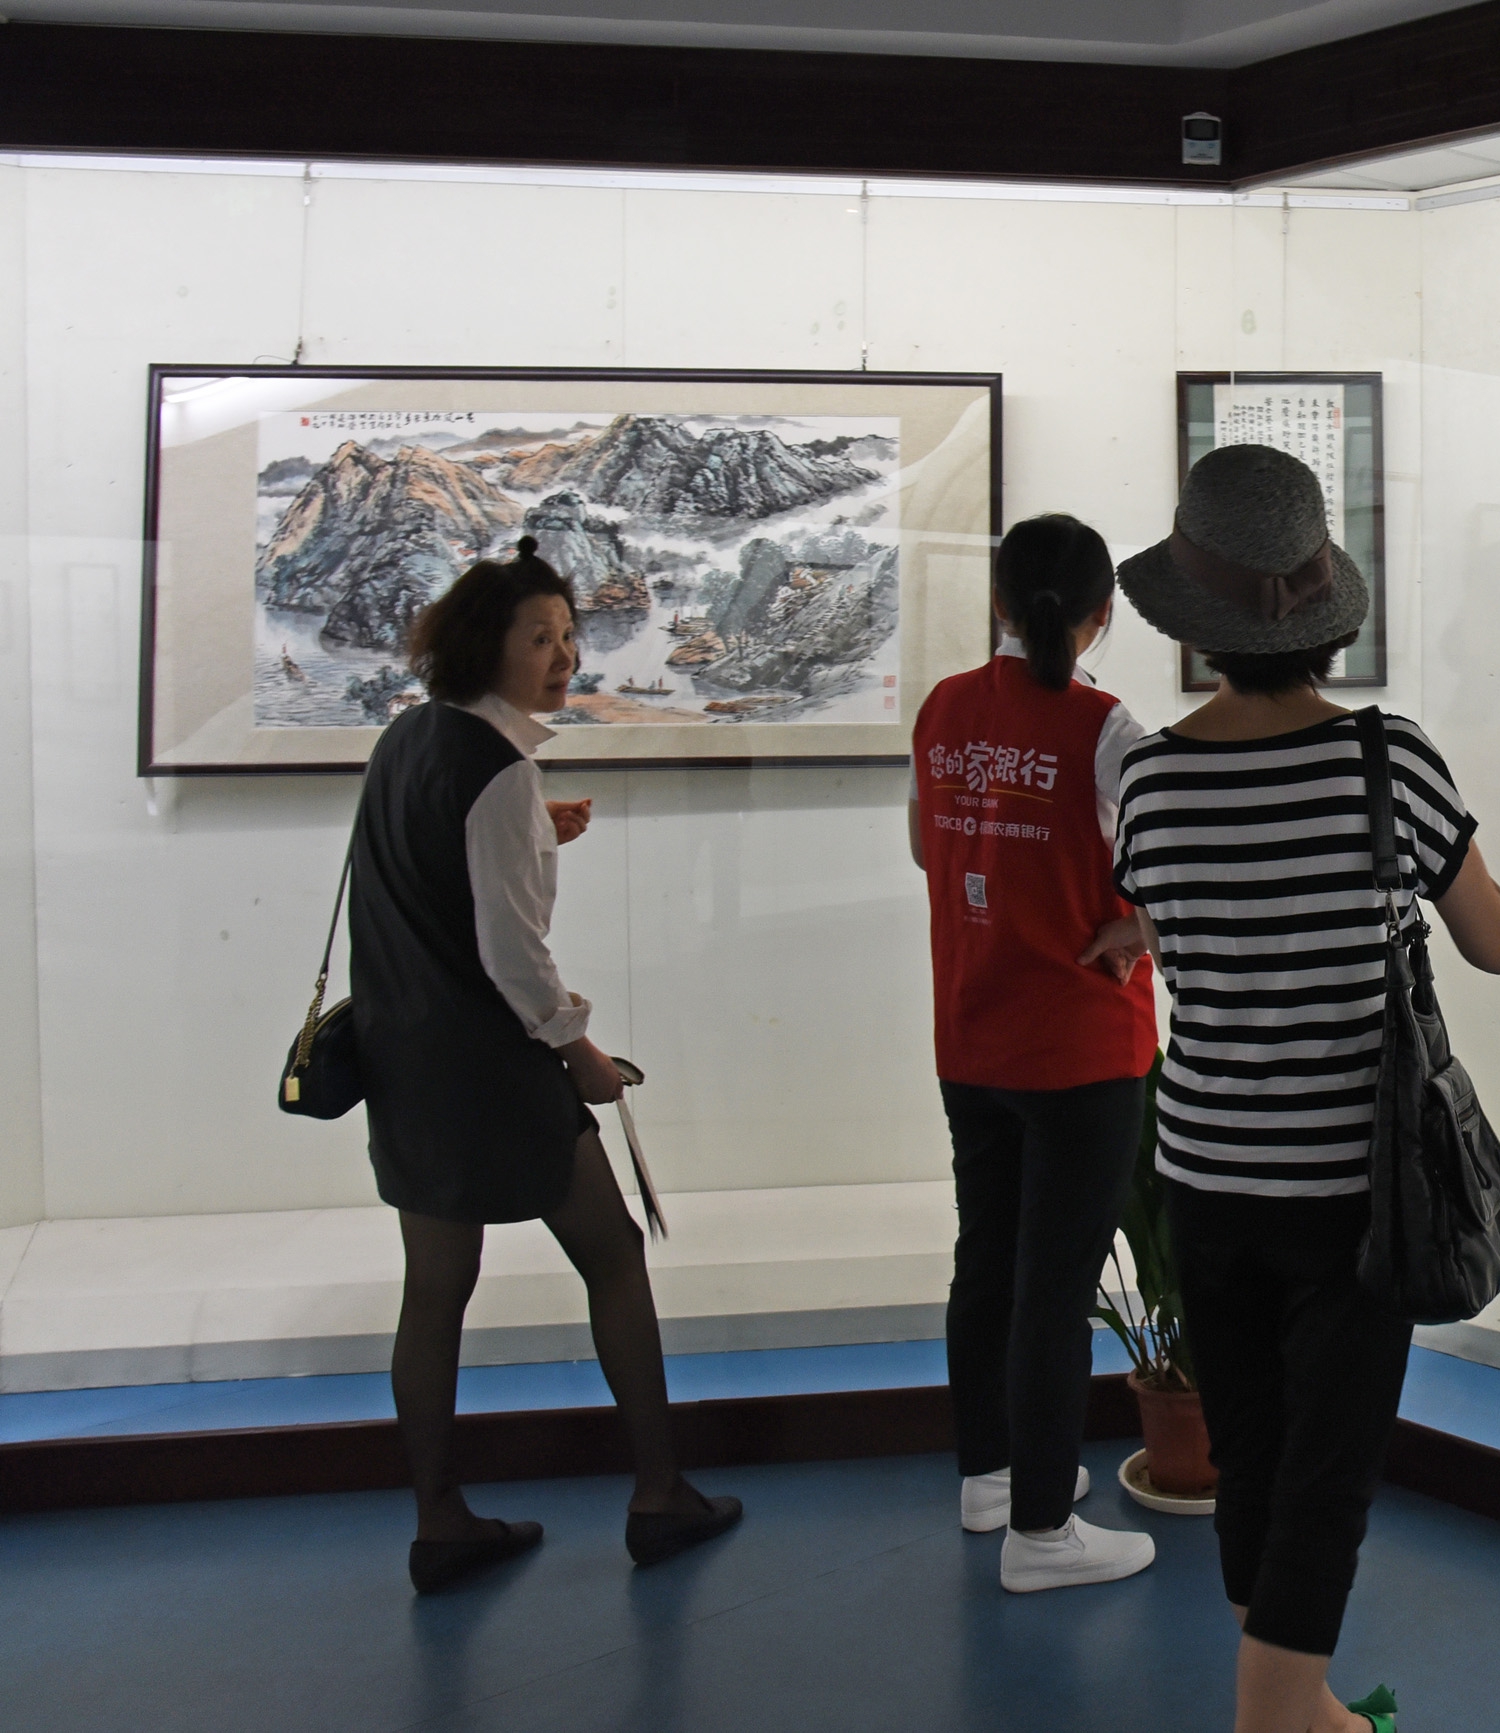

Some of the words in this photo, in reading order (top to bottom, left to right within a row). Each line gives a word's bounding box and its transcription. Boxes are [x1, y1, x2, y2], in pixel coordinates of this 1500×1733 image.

[928, 741, 1058, 793] 您的家银行
[954, 794, 980, 807] YOUR
